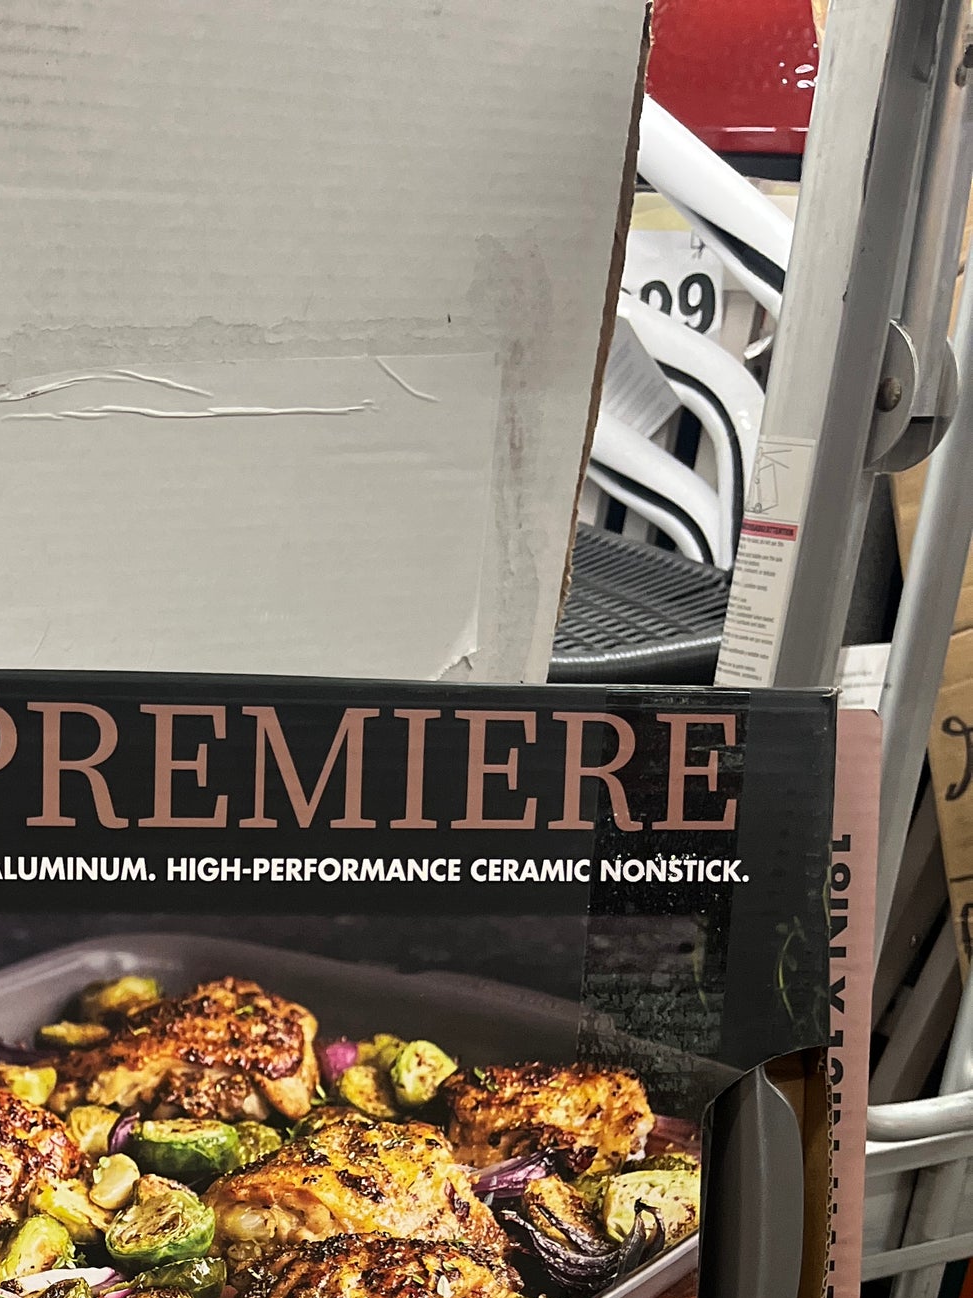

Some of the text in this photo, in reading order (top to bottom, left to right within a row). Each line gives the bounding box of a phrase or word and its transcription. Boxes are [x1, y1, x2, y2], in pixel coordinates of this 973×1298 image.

[166, 857, 461, 883] HIGH-PERFORMANCE
[470, 858, 591, 884] CERAMIC
[600, 858, 750, 884] NONSTICK.
